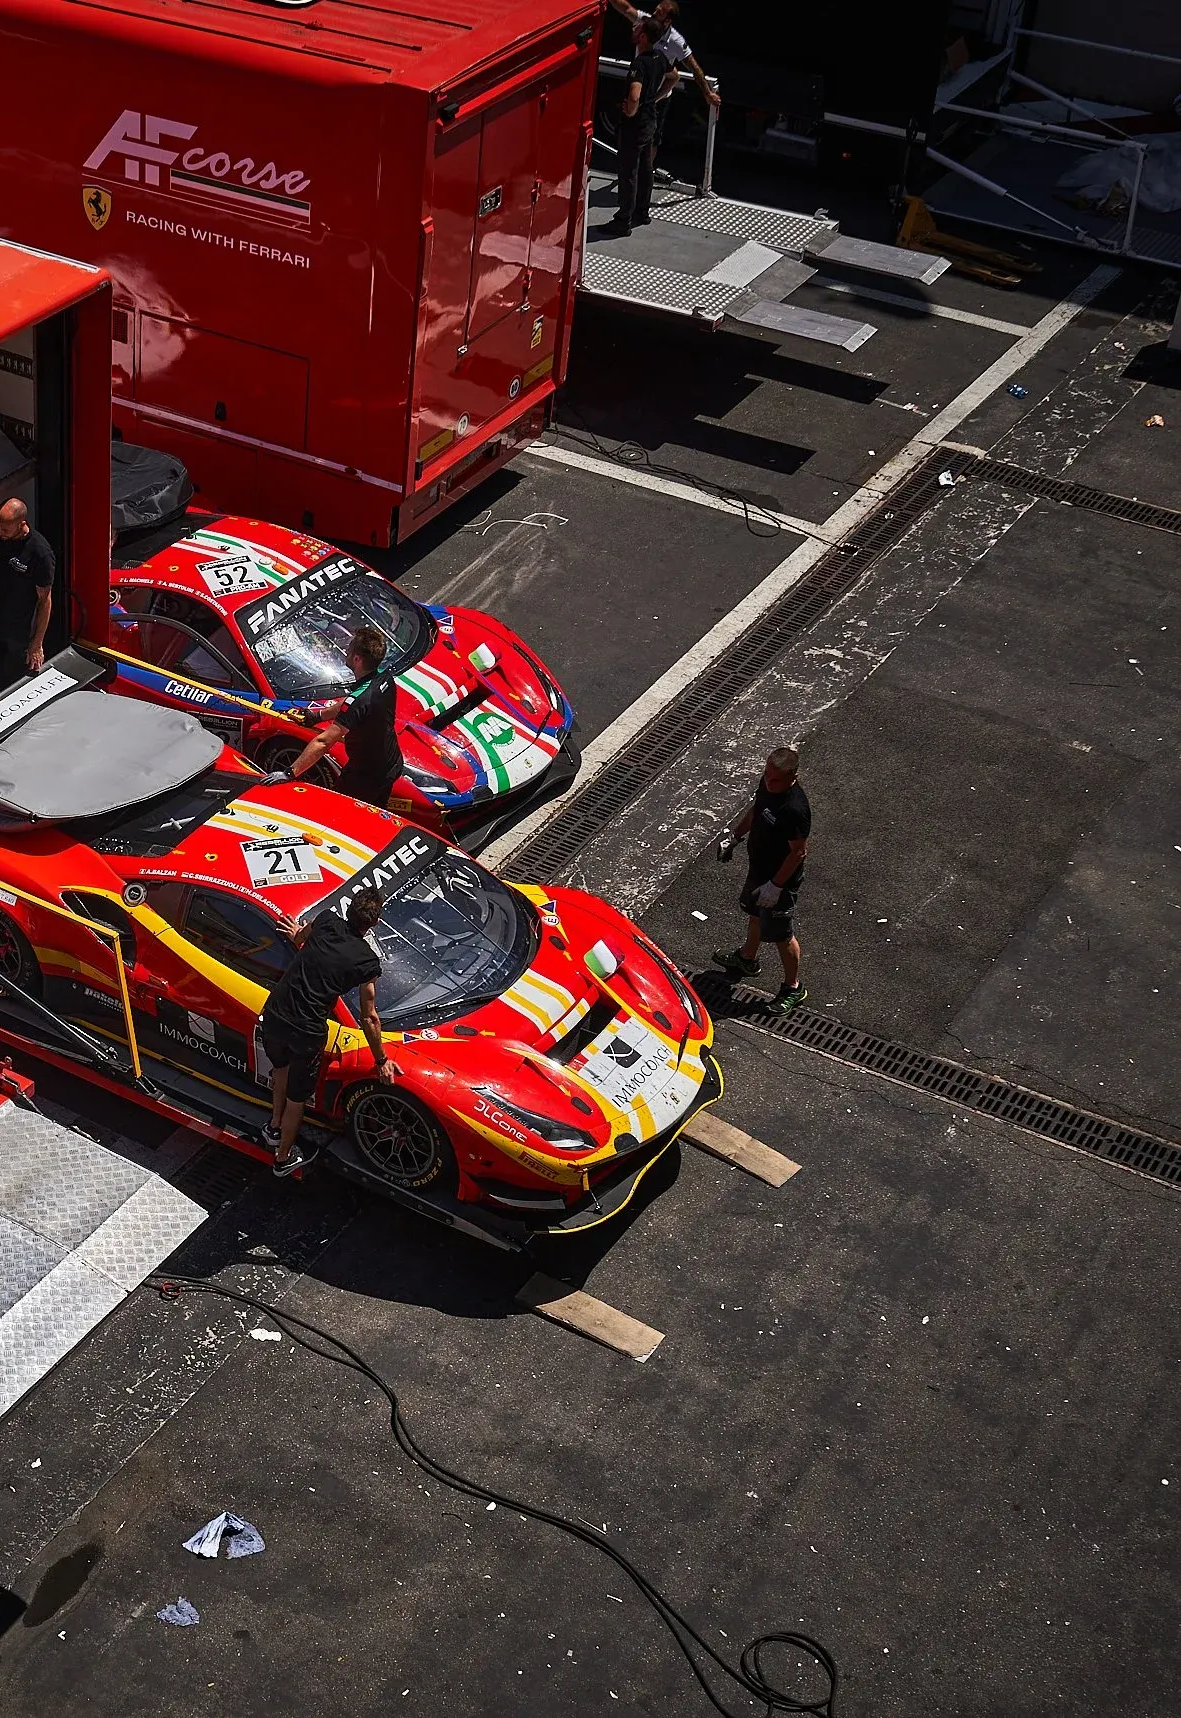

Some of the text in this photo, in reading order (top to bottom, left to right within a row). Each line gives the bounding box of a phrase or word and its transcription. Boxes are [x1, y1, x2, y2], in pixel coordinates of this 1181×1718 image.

[180, 145, 312, 195] corse
[125, 210, 311, 270] RACING WITH FERRARI
[213, 565, 254, 588] 52
[230, 582, 260, 593] PRO-AM
[247, 557, 356, 635] FANATEC
[164, 679, 214, 705] Cetilar
[146, 868, 178, 877] A.BALZAN
[263, 848, 302, 875] 21
[279, 874, 309, 883] GOLD
[330, 836, 430, 922] AATEC
[158, 1022, 247, 1073] IMMOCOACH
[611, 1044, 673, 1108] IMMOCOACH
[346, 1084, 375, 1113] PIRELLI
[412, 1166, 440, 1188] ZERO
[517, 1150, 560, 1181] PIRELLI
